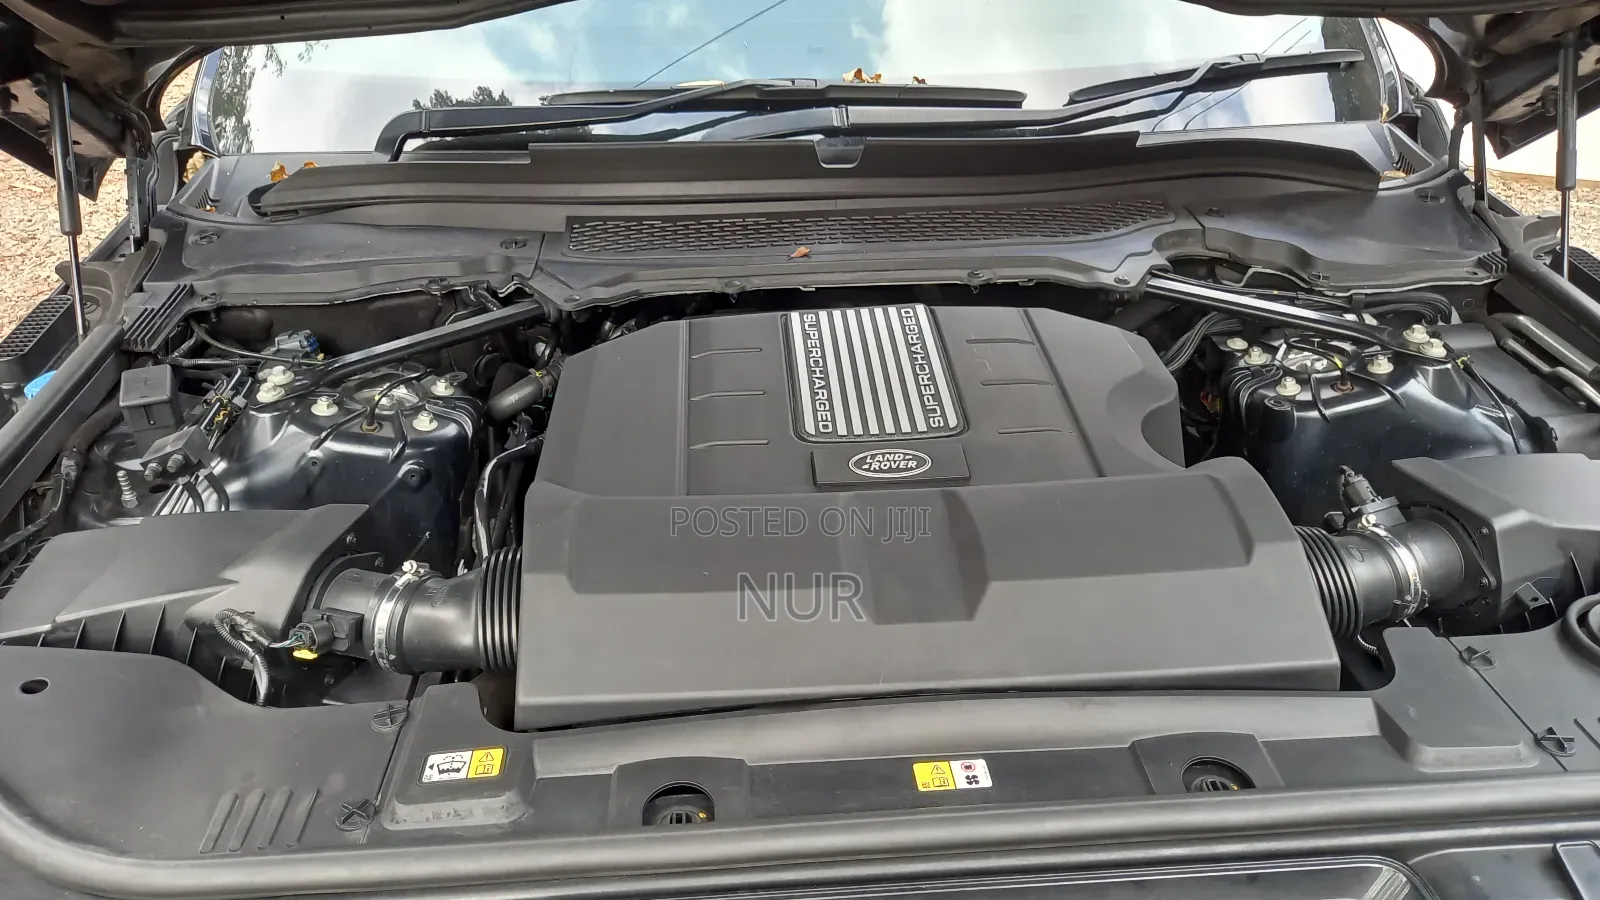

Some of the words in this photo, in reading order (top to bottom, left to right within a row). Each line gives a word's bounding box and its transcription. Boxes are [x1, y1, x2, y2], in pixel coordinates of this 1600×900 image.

[803, 313, 833, 433] SUPERCHARGED
[900, 308, 944, 428] SUPERCHARGED
[865, 453, 905, 463] LAND
[869, 461, 918, 471] ROVER
